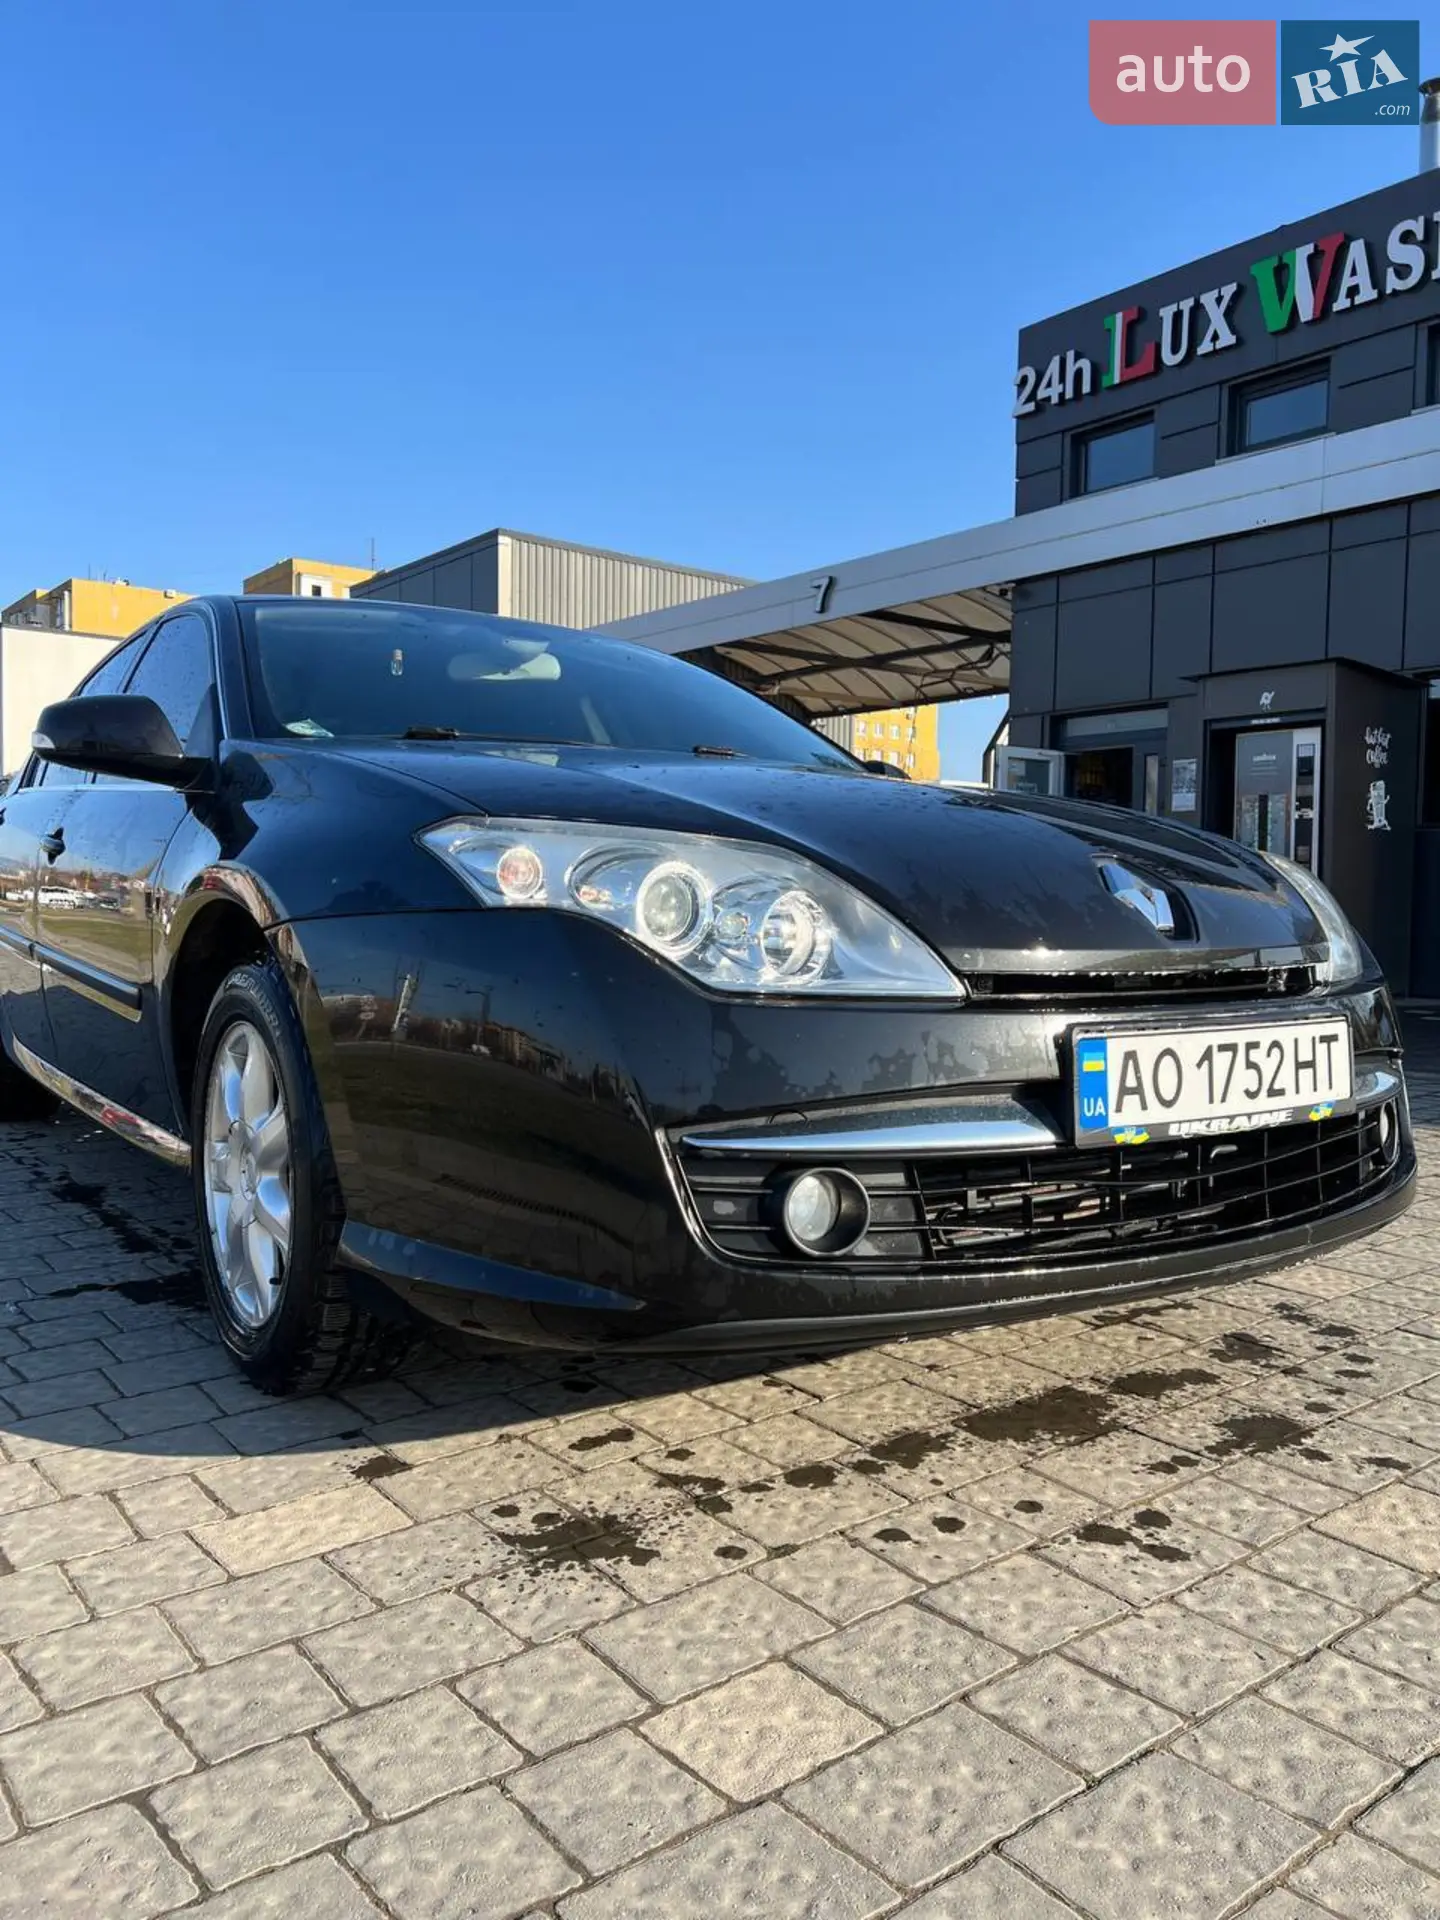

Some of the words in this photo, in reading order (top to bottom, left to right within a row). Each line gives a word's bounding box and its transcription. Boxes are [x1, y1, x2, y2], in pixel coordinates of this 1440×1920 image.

[1012, 350, 1092, 418] 24h
[1103, 283, 1238, 389] LUX
[1249, 211, 1440, 334] WAS
[811, 575, 834, 614] 7
[1114, 1047, 1183, 1113] AO
[1196, 1040, 1286, 1105] 1752
[1083, 1101, 1107, 1118] UA
[1168, 1110, 1294, 1138] UKRAINE
